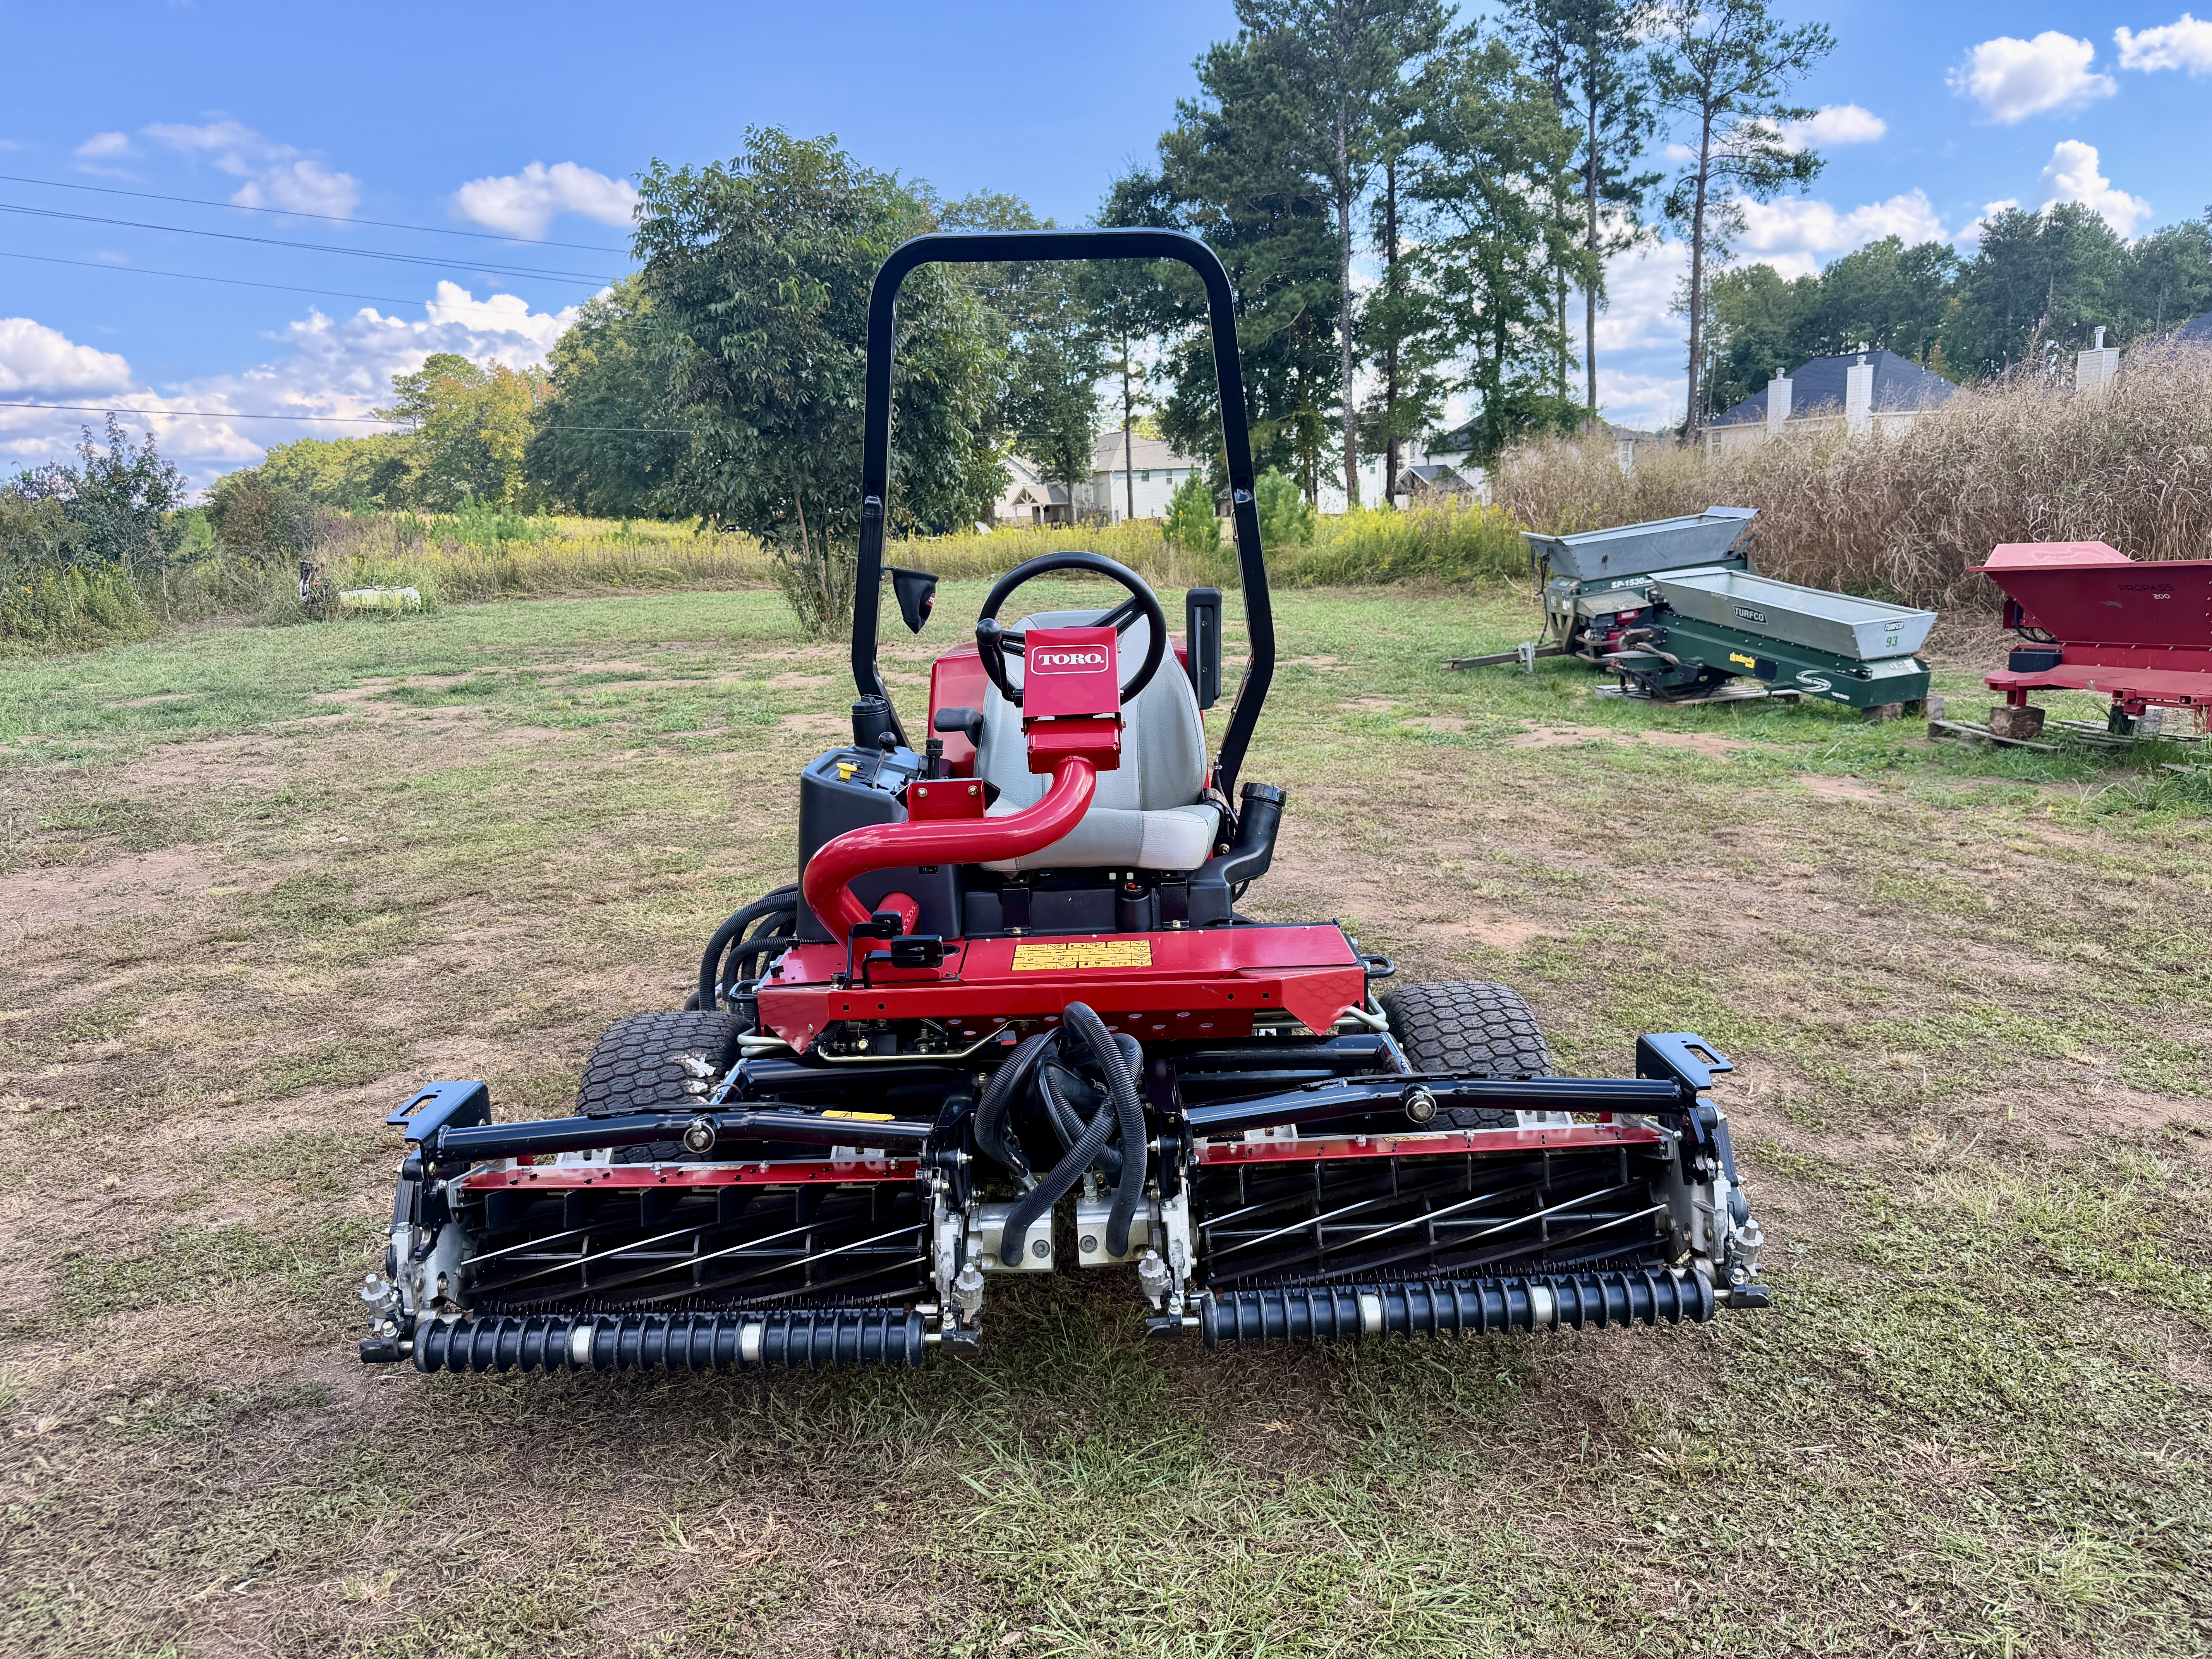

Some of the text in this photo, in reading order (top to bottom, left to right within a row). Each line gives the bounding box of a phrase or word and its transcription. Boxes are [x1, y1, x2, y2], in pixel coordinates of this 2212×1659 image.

[1611, 577, 1644, 589] SP-1530
[1735, 607, 1765, 622] TURFCO
[1884, 622, 1904, 631] TURFCO
[1886, 635, 1898, 647] 93
[1831, 691, 1850, 700] 1530
